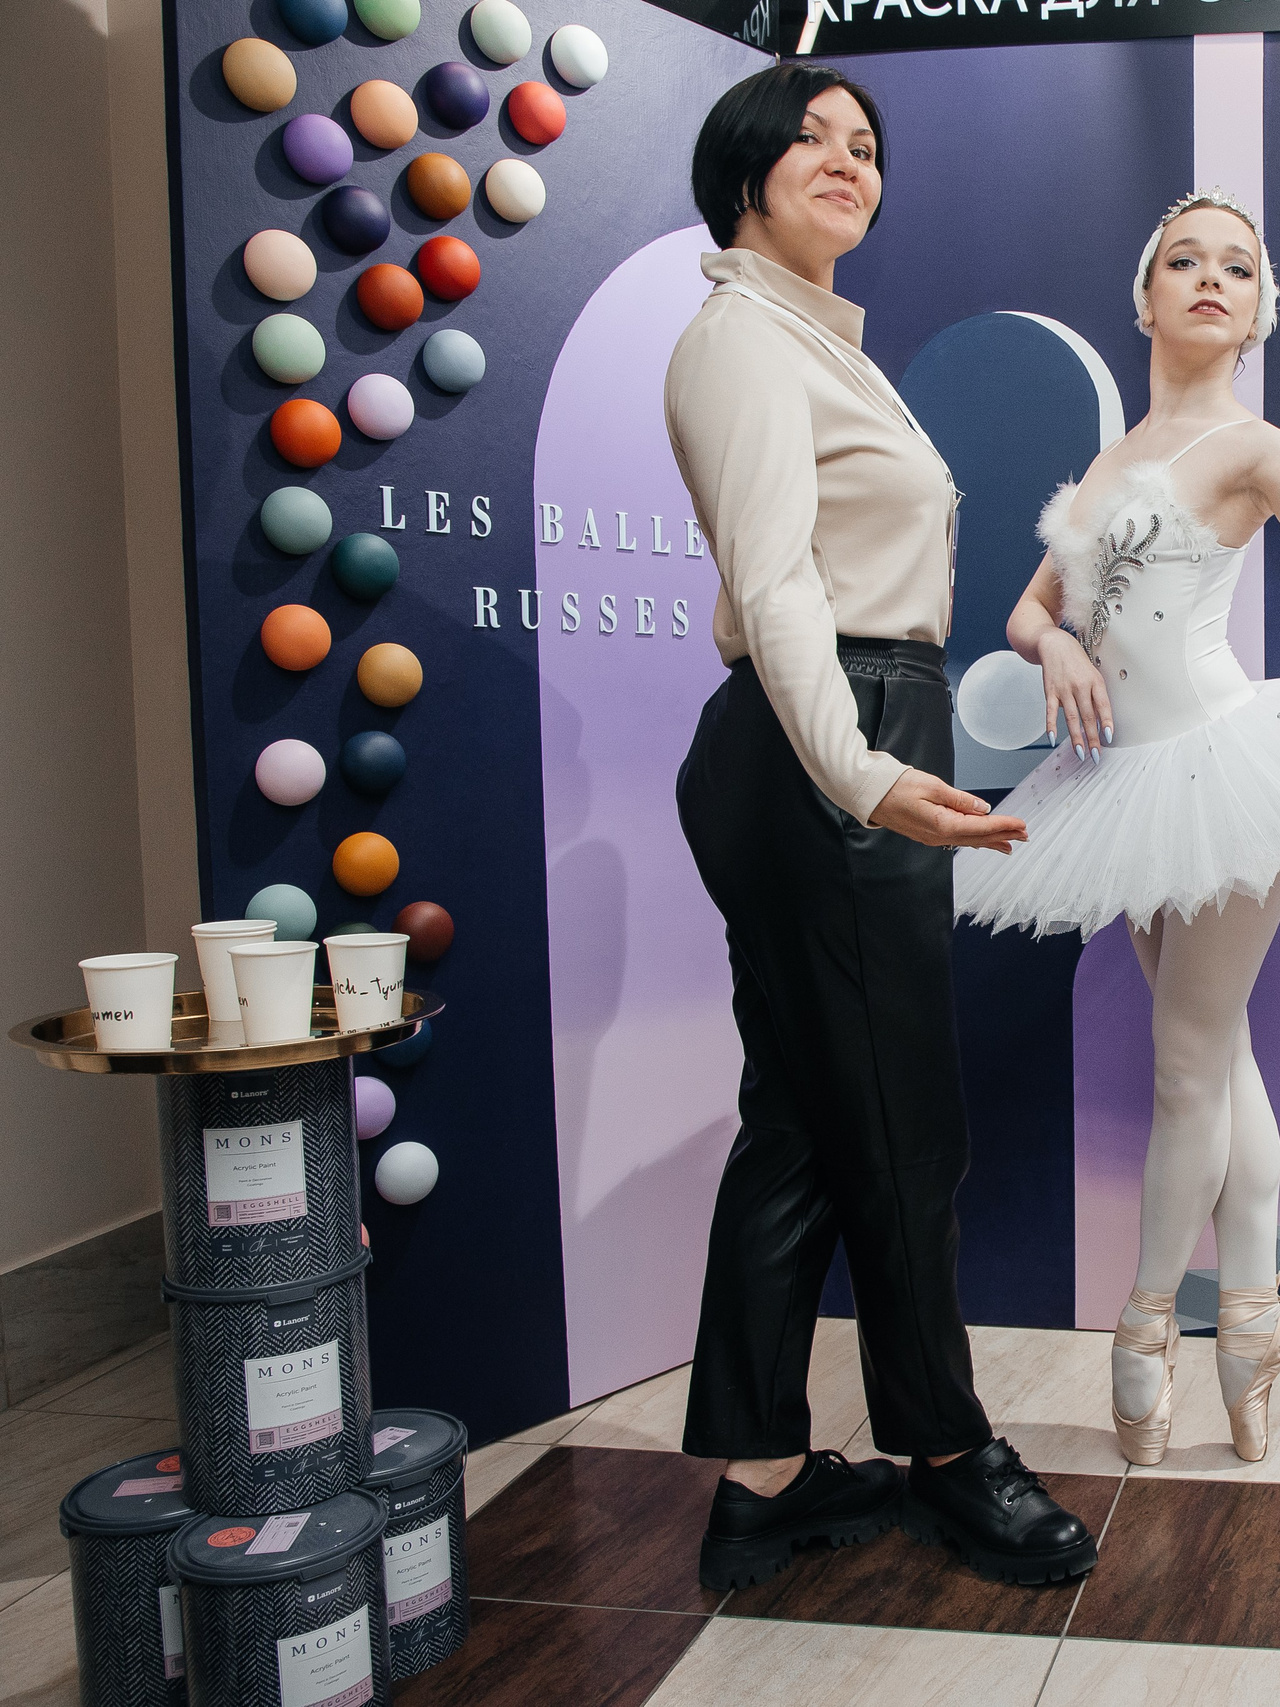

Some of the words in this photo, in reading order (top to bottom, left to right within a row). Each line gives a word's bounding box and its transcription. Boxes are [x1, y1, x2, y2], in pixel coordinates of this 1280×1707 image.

[807, 0, 1028, 23] КРА
[379, 485, 492, 537] LES
[473, 586, 690, 637] RUSSES
[215, 1131, 292, 1150] MONS
[242, 1196, 300, 1209] EGGSHELL
[258, 1352, 330, 1379] MONS
[286, 1414, 337, 1434] EGGSHELL
[405, 1583, 449, 1607] EGGSHELL
[291, 1619, 361, 1658] MONS
